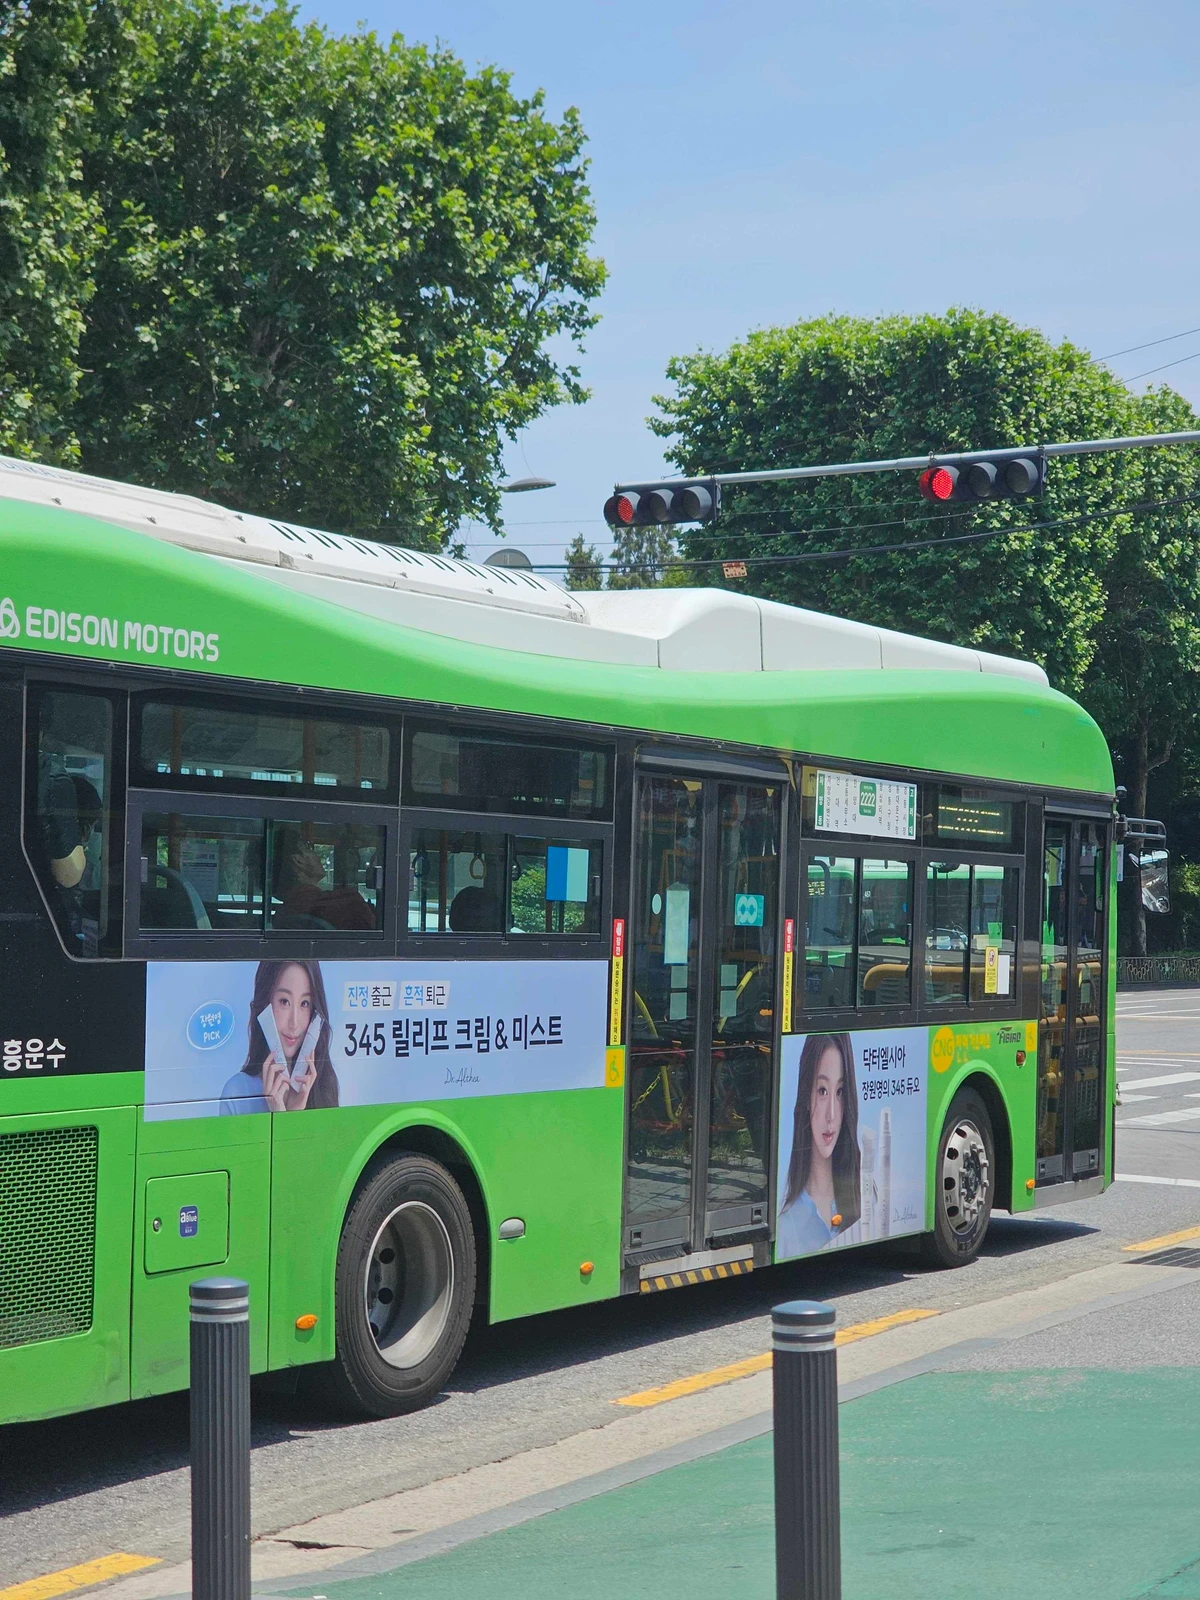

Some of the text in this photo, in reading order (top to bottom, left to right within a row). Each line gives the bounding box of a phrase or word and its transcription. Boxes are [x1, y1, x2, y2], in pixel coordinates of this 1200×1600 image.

[25, 606, 220, 662] EDISON MOTORS
[860, 791, 876, 807] 2222
[348, 985, 392, 1007] 진정 출근
[404, 984, 446, 1006] 흔적 퇴근
[203, 1030, 220, 1043] PICK
[344, 1022, 386, 1057] 345
[392, 1018, 450, 1058] 릴리프
[933, 1038, 954, 1057] CNG
[2, 1038, 67, 1071] 흥운수
[863, 1044, 906, 1072] 닥터엘시아
[861, 1076, 920, 1101] 장원영의 345 듀오
